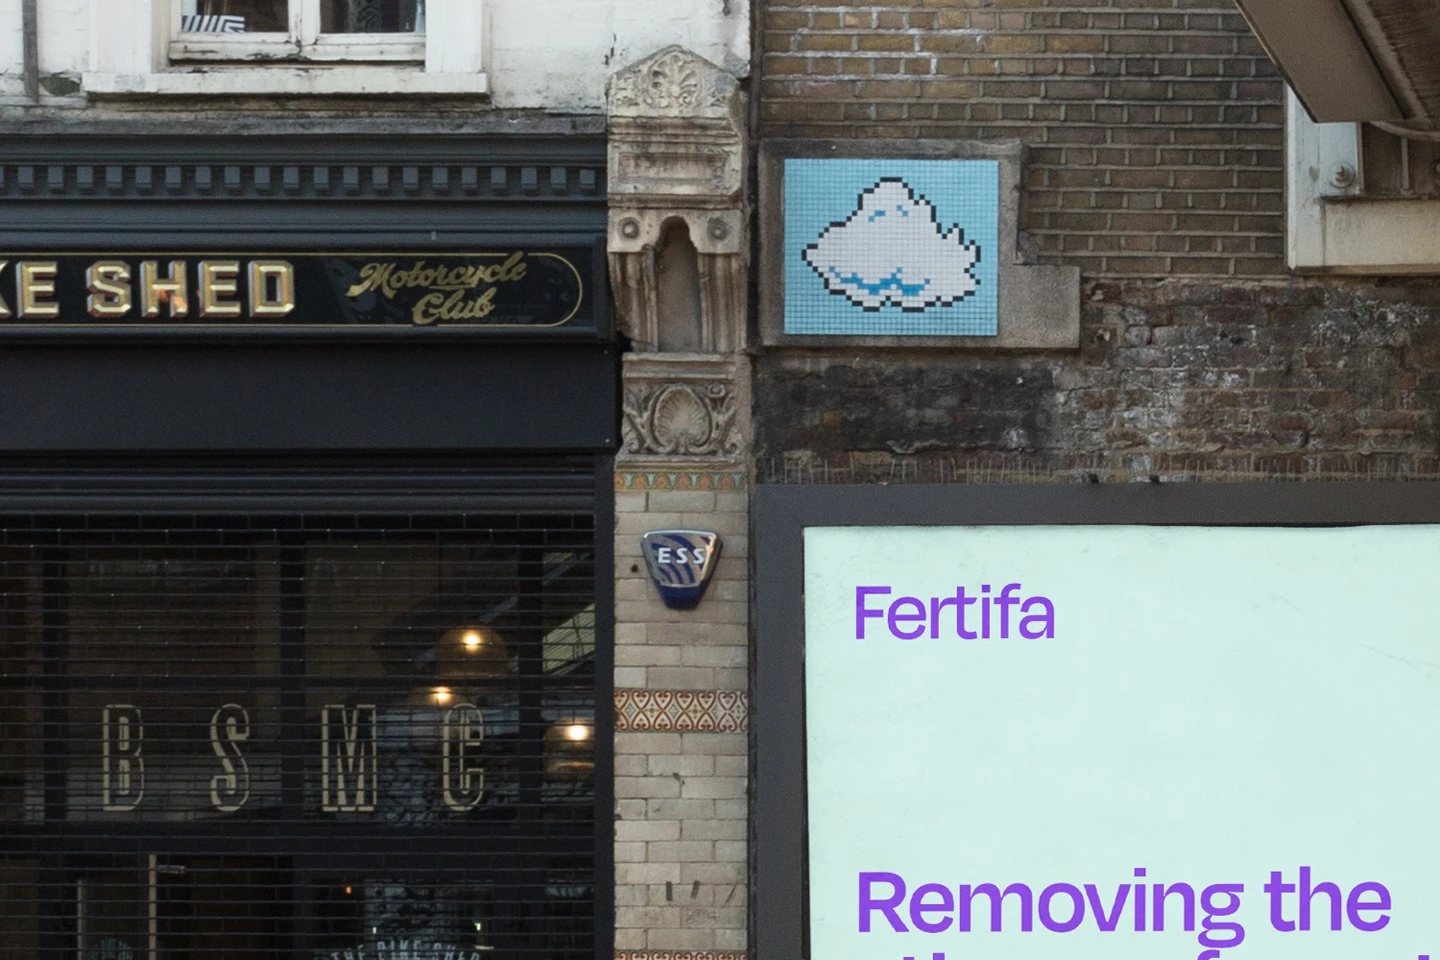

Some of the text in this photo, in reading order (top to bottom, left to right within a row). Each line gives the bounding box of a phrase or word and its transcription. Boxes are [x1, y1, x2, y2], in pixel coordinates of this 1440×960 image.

[86, 260, 296, 318] SHED
[344, 251, 527, 299] Motorcycle
[412, 287, 498, 325] Club
[657, 547, 705, 564] ESS
[856, 583, 1055, 640] Fertifa
[859, 866, 1392, 949] Removing the
